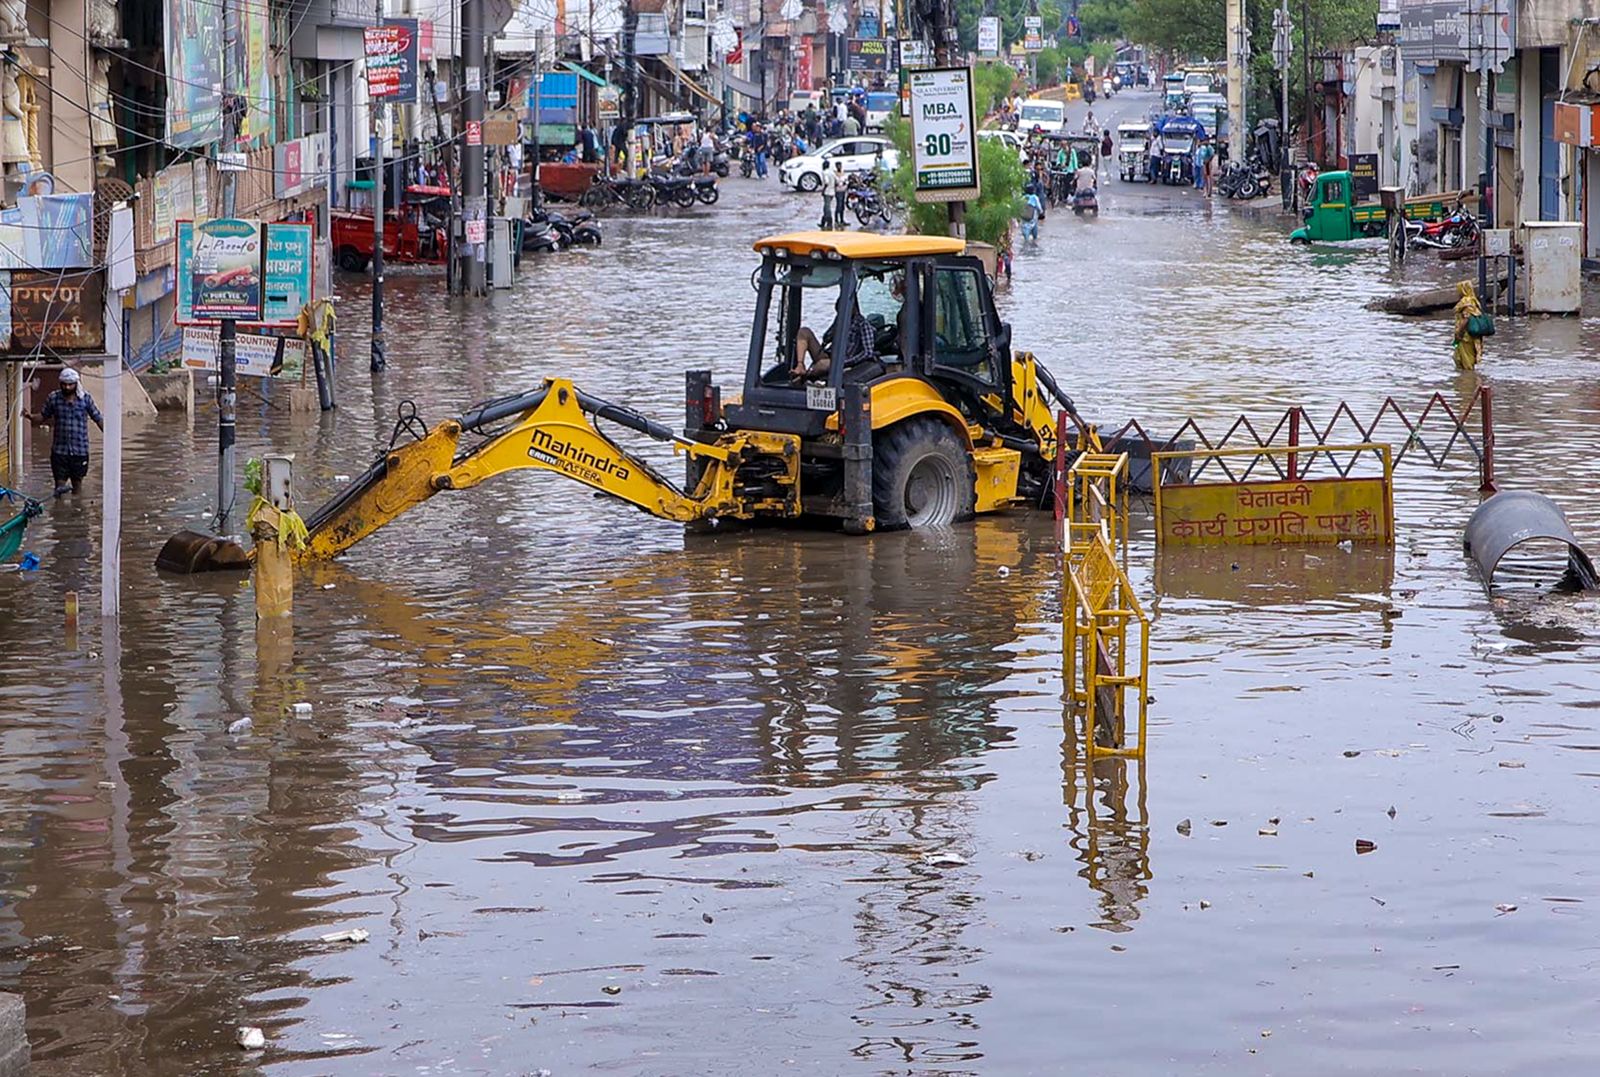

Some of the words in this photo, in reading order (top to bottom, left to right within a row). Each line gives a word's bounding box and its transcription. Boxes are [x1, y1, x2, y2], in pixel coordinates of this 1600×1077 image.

[923, 102, 957, 115] MBA
[185, 329, 219, 341] BUSINES
[286, 340, 303, 350] OME
[531, 428, 630, 481] Mahindra
[1238, 484, 1313, 509] चेतावनी
[1171, 513, 1227, 539] कार्य
[1233, 511, 1309, 538] प्रगति
[1315, 514, 1351, 532] पर
